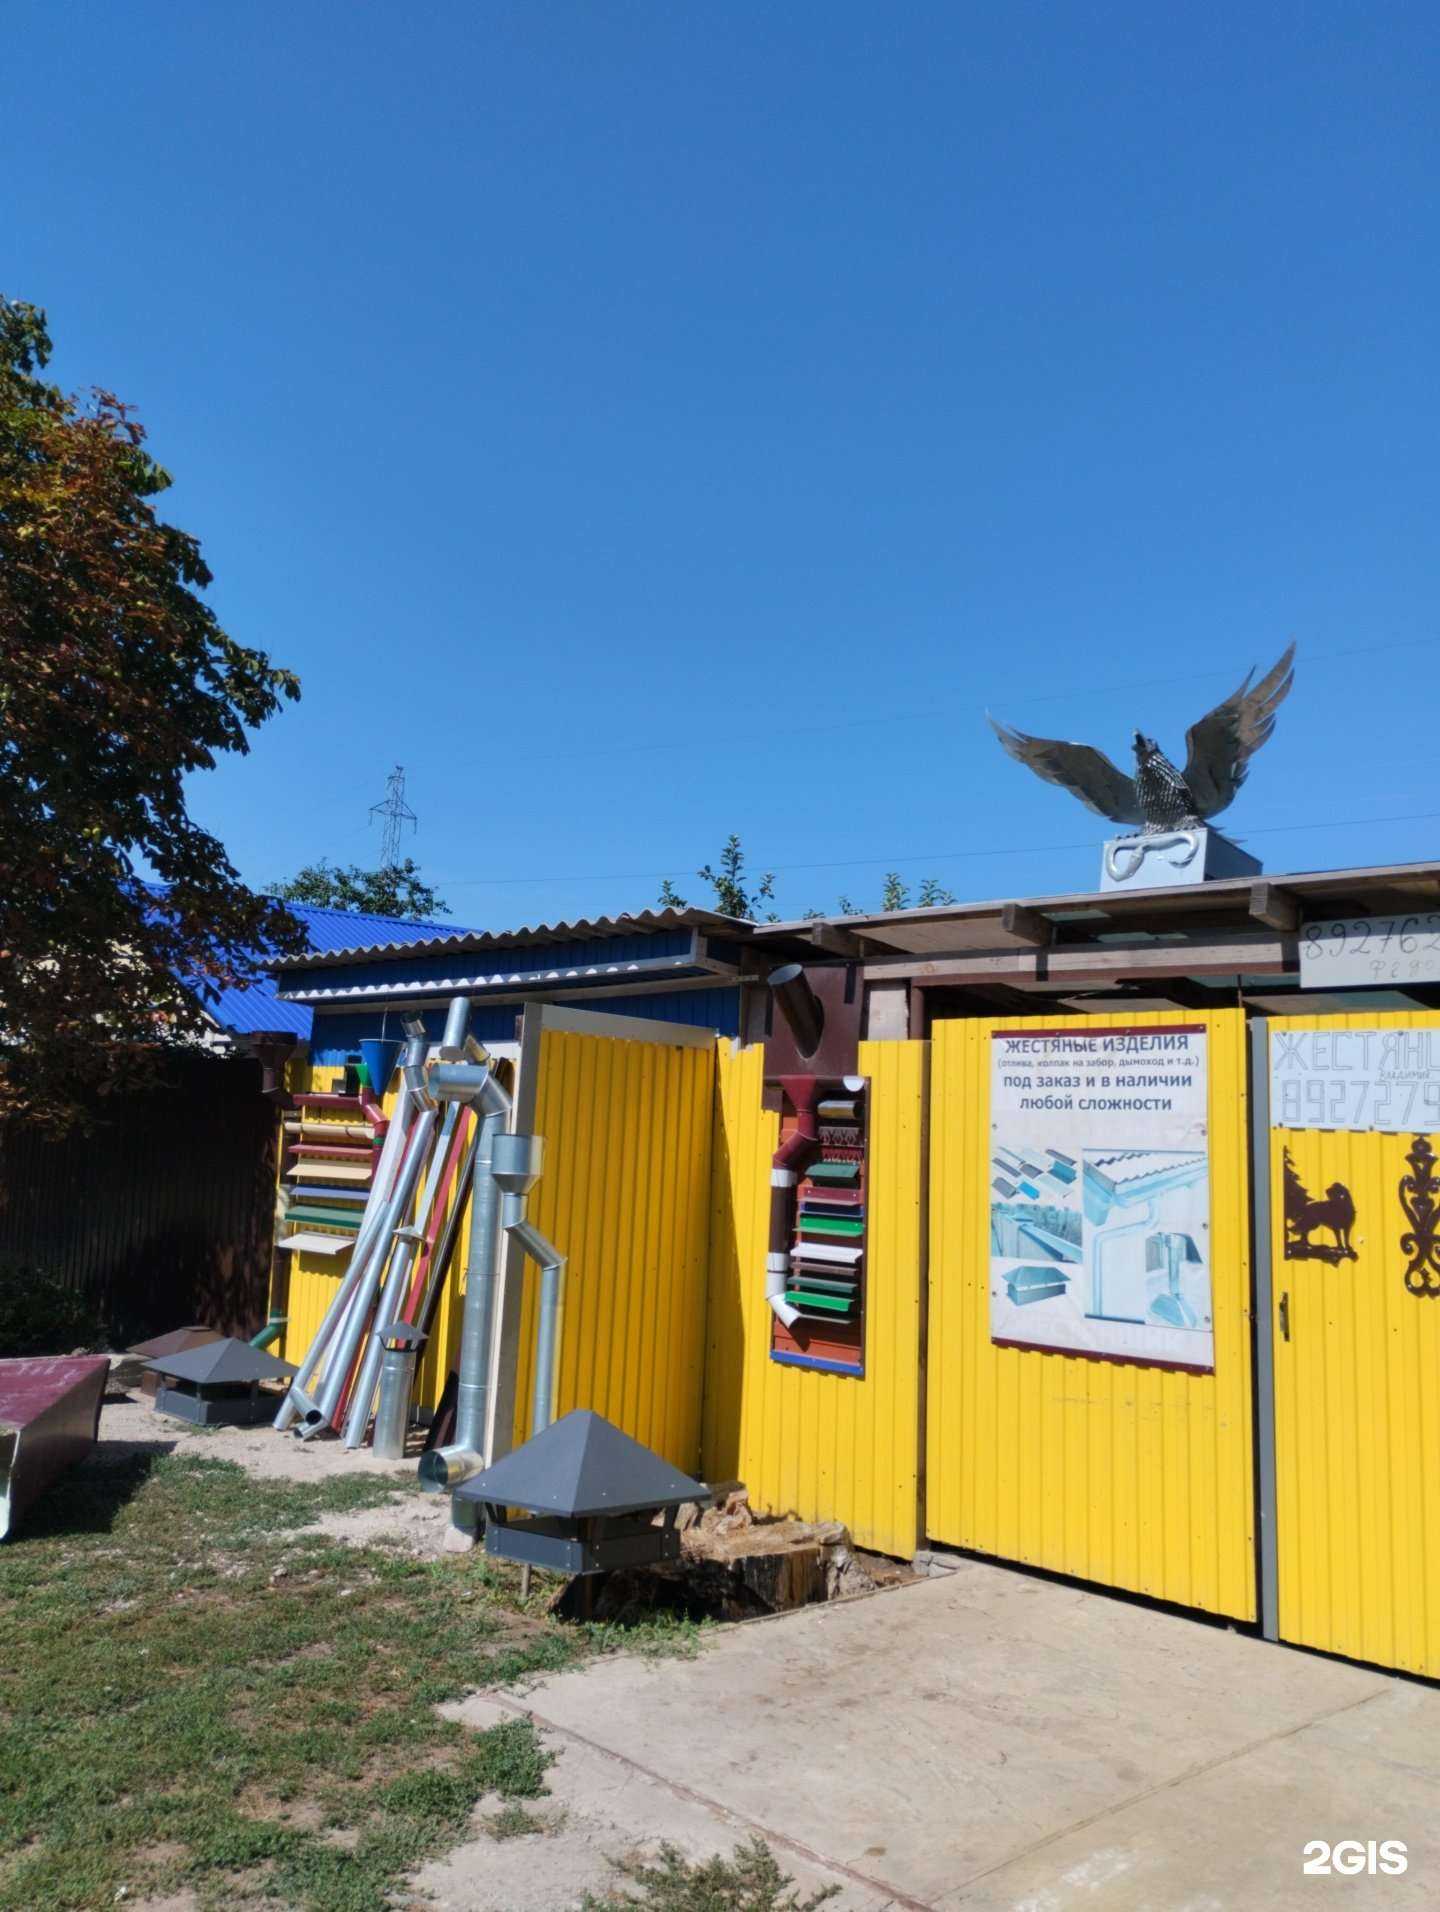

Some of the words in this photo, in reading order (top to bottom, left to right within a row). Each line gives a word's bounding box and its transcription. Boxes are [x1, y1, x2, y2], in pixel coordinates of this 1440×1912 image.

[1005, 1037, 1098, 1054] ЖЕСТЯНЫЕ
[1102, 1034, 1189, 1054] ИЗДЕЛИЯ
[1072, 1059, 1084, 1068] на
[1118, 1057, 1165, 1068] дымоход
[1166, 1057, 1174, 1066] и
[1003, 1075, 1032, 1089] под
[1036, 1075, 1081, 1088] заказ
[1086, 1076, 1095, 1087] и
[1101, 1075, 1111, 1087] в
[1115, 1073, 1192, 1088] наличии
[1019, 1095, 1073, 1110] любой
[1078, 1097, 1173, 1111] сложности
